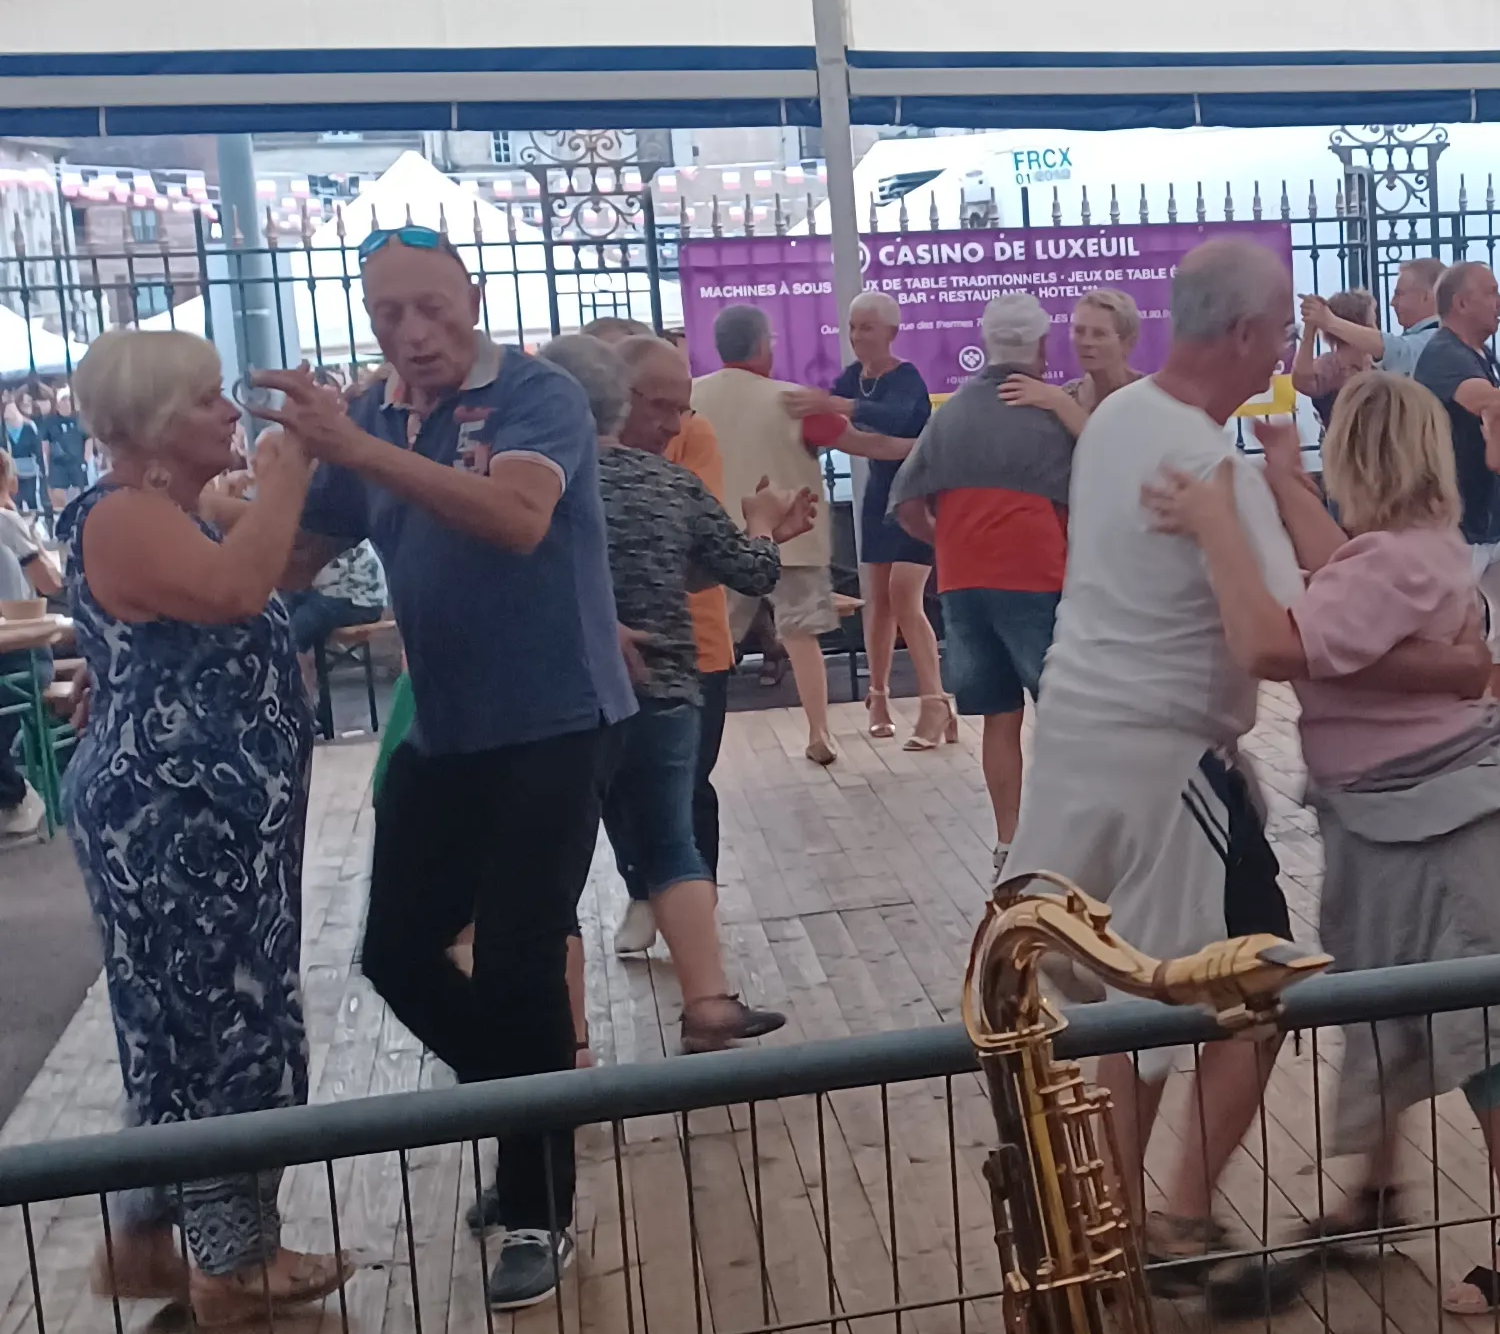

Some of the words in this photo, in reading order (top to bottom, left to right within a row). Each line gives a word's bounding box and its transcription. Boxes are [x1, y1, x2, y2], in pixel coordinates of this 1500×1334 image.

[1013, 147, 1073, 171] FRCX
[879, 241, 985, 266] CASINO
[994, 240, 1026, 262] DE
[1035, 236, 1140, 260] LUXEUIL
[700, 283, 776, 298] MACHINES
[779, 281, 790, 296] À
[793, 281, 832, 295] SOUS
[882, 278, 902, 290] DE
[904, 276, 948, 289] TABLE
[950, 272, 1057, 288] TRADITIONNELS
[1067, 269, 1102, 283] JEUX
[1106, 268, 1124, 280] DE
[1126, 267, 1167, 279] TABLE
[898, 292, 927, 305] BAR
